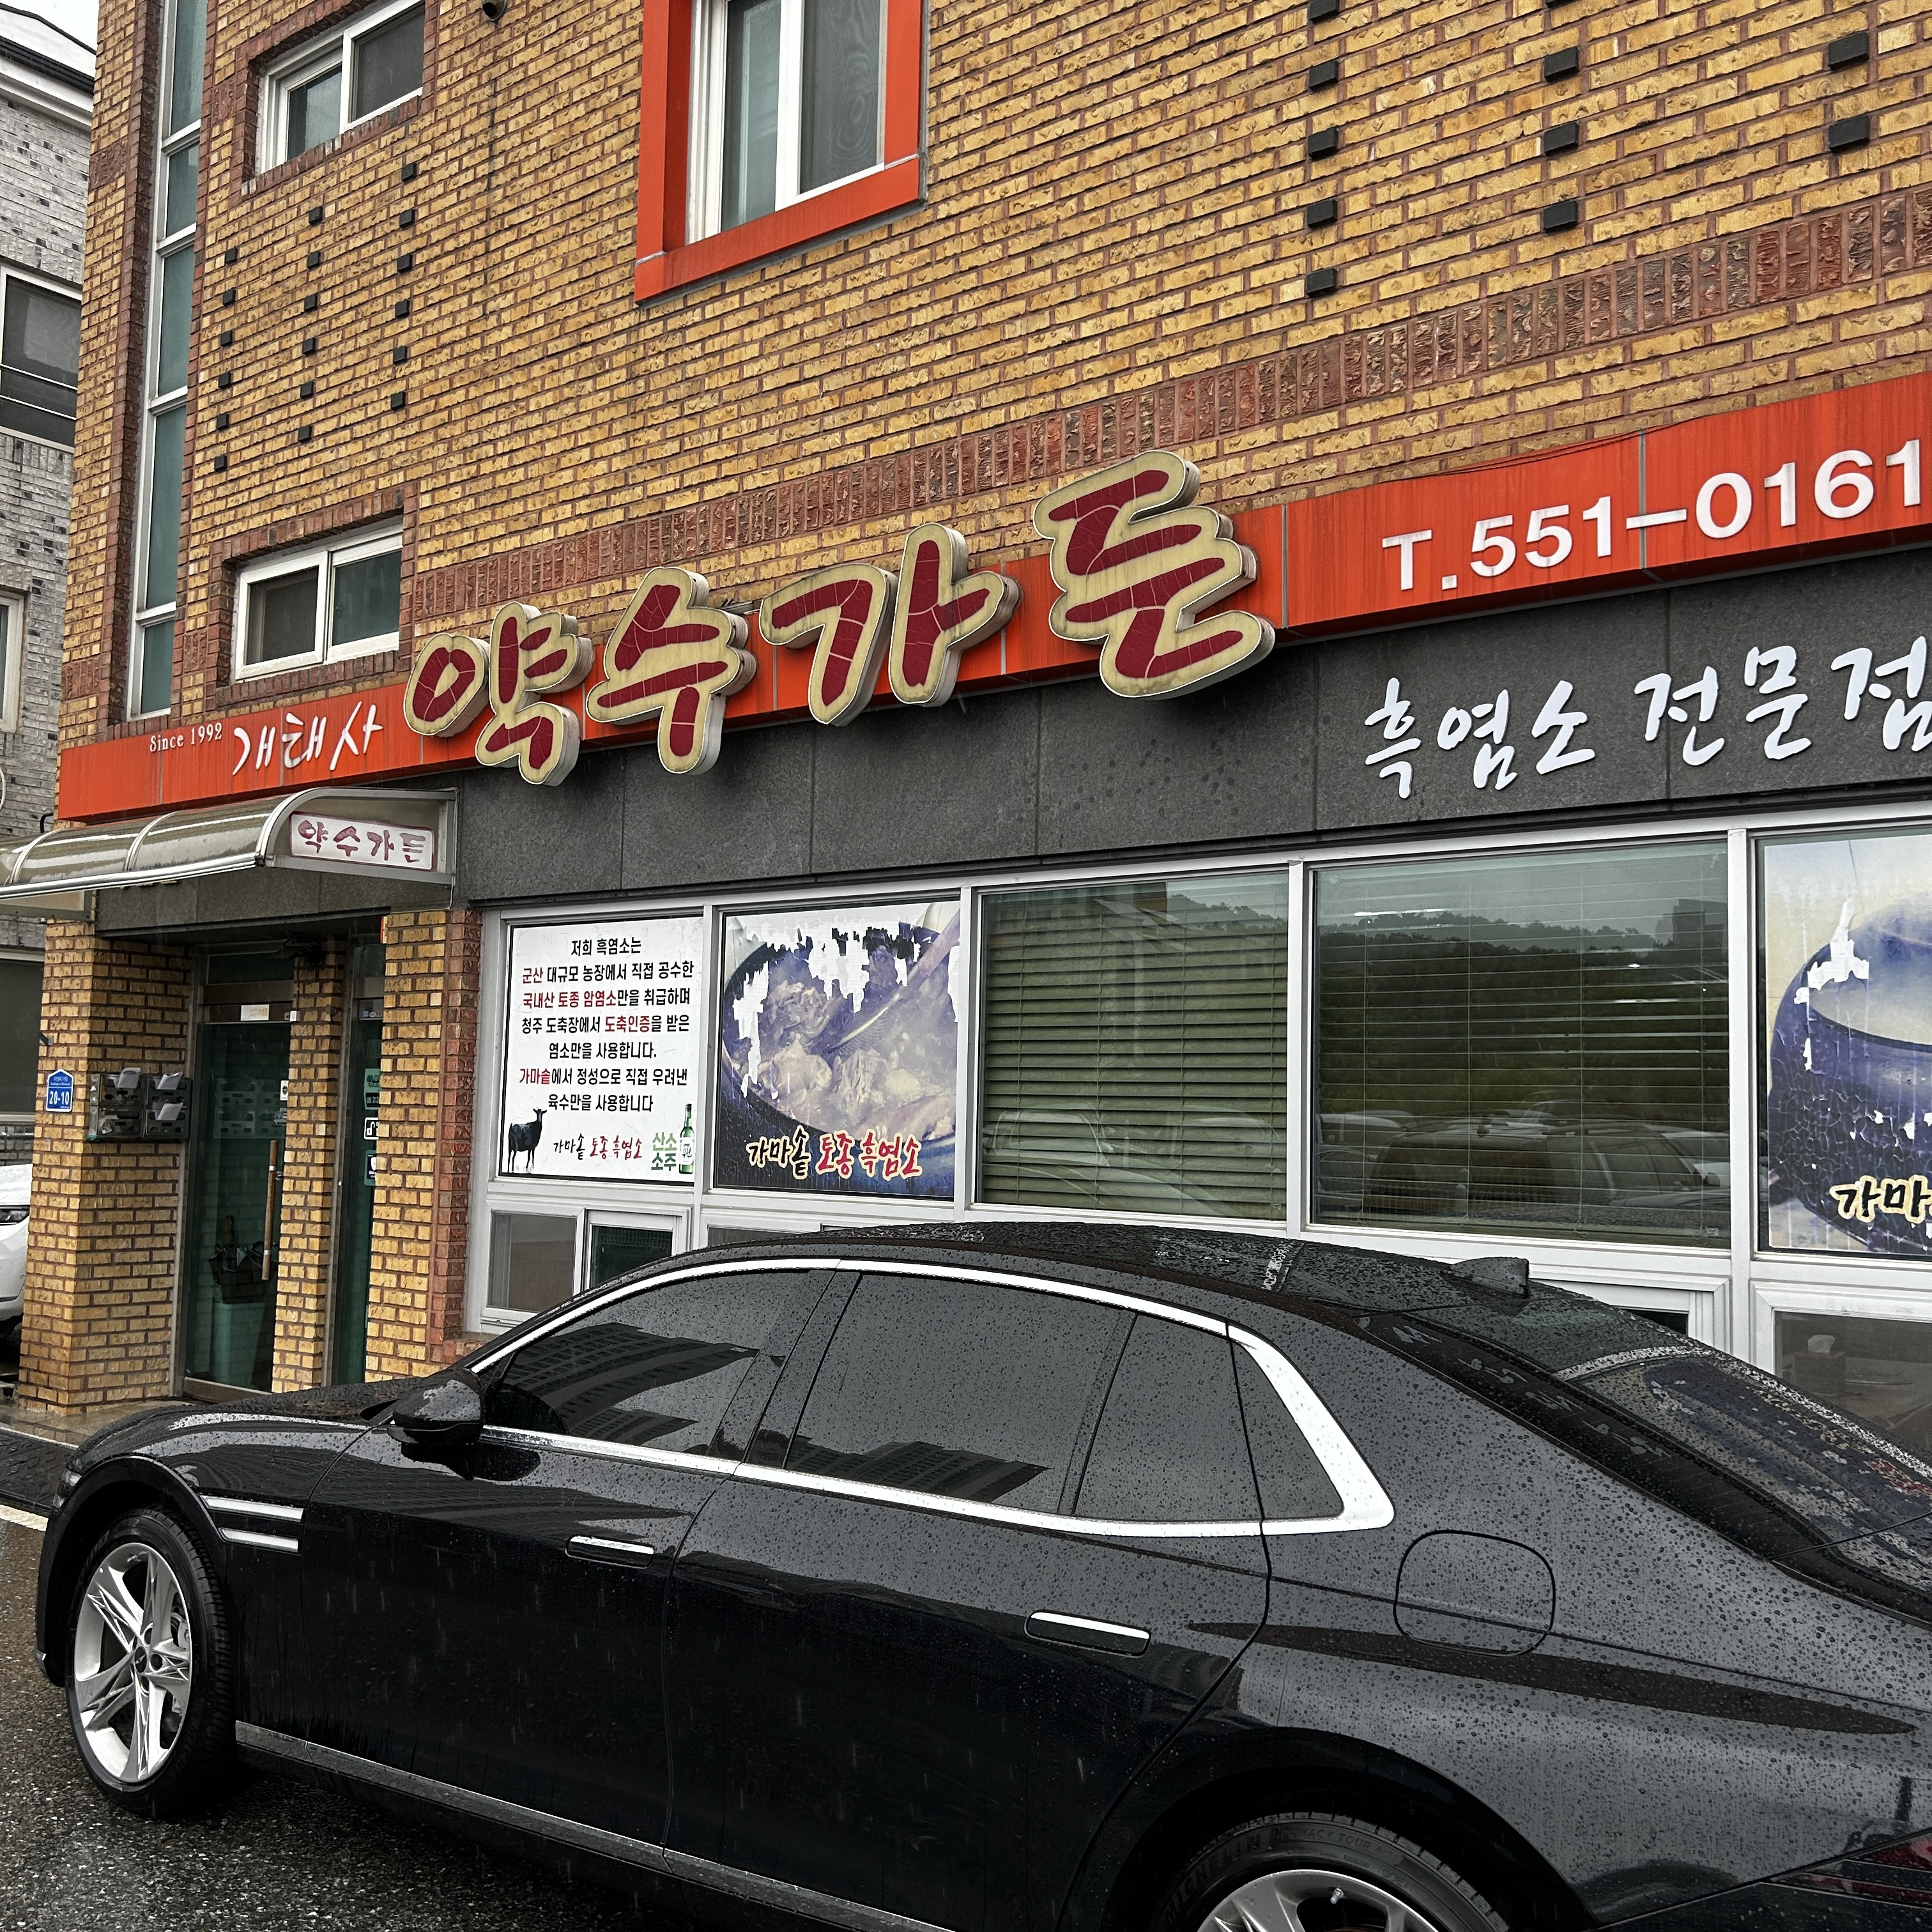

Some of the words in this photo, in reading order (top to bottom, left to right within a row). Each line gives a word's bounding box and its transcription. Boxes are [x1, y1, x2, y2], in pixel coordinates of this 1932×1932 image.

[404, 450, 1275, 786] 약수가든
[1364, 676, 1595, 799] 흑염소
[1634, 635, 1932, 767] 전문점
[150, 733, 184, 752] Since
[190, 722, 222, 745] 1992
[298, 820, 427, 863] 약수가든
[571, 939, 592, 956] 저희
[596, 937, 641, 956] 흑염소는
[522, 967, 544, 985] 군산
[547, 965, 579, 983] 대규모
[583, 963, 627, 982] 농장에서
[631, 962, 654, 980] 직접
[658, 960, 694, 979] 공수한
[523, 992, 555, 1009] 국내산
[558, 991, 579, 1008] 토종
[583, 989, 640, 1008] 암염소만을
[643, 987, 691, 1006] 취급하며
[521, 1017, 542, 1034] 청주
[546, 1016, 601, 1034] 도축장에서
[604, 1015, 663, 1033] 도축인증을
[666, 1014, 690, 1032] 받은
[549, 1042, 592, 1059] 염소만을
[595, 1041, 657, 1059] 사용합니다.
[519, 1068, 572, 1085] 가마솥에서
[577, 1068, 621, 1085] 정성으로
[625, 1068, 648, 1086] 직접
[652, 1068, 687, 1086] 우려낸
[548, 1094, 592, 1111] 육수만을
[595, 1094, 654, 1112] 사용합니다
[553, 1132, 586, 1160] 가마솥
[590, 1135, 609, 1160] 토종
[612, 1135, 643, 1161] 흑염소
[652, 1131, 677, 1151] 산소
[747, 1126, 811, 1178] 가마솥
[816, 1131, 854, 1177] 토종
[859, 1130, 922, 1179] 흑염소
[650, 1152, 677, 1172] 소주
[1831, 1176, 1932, 1222] 가마
